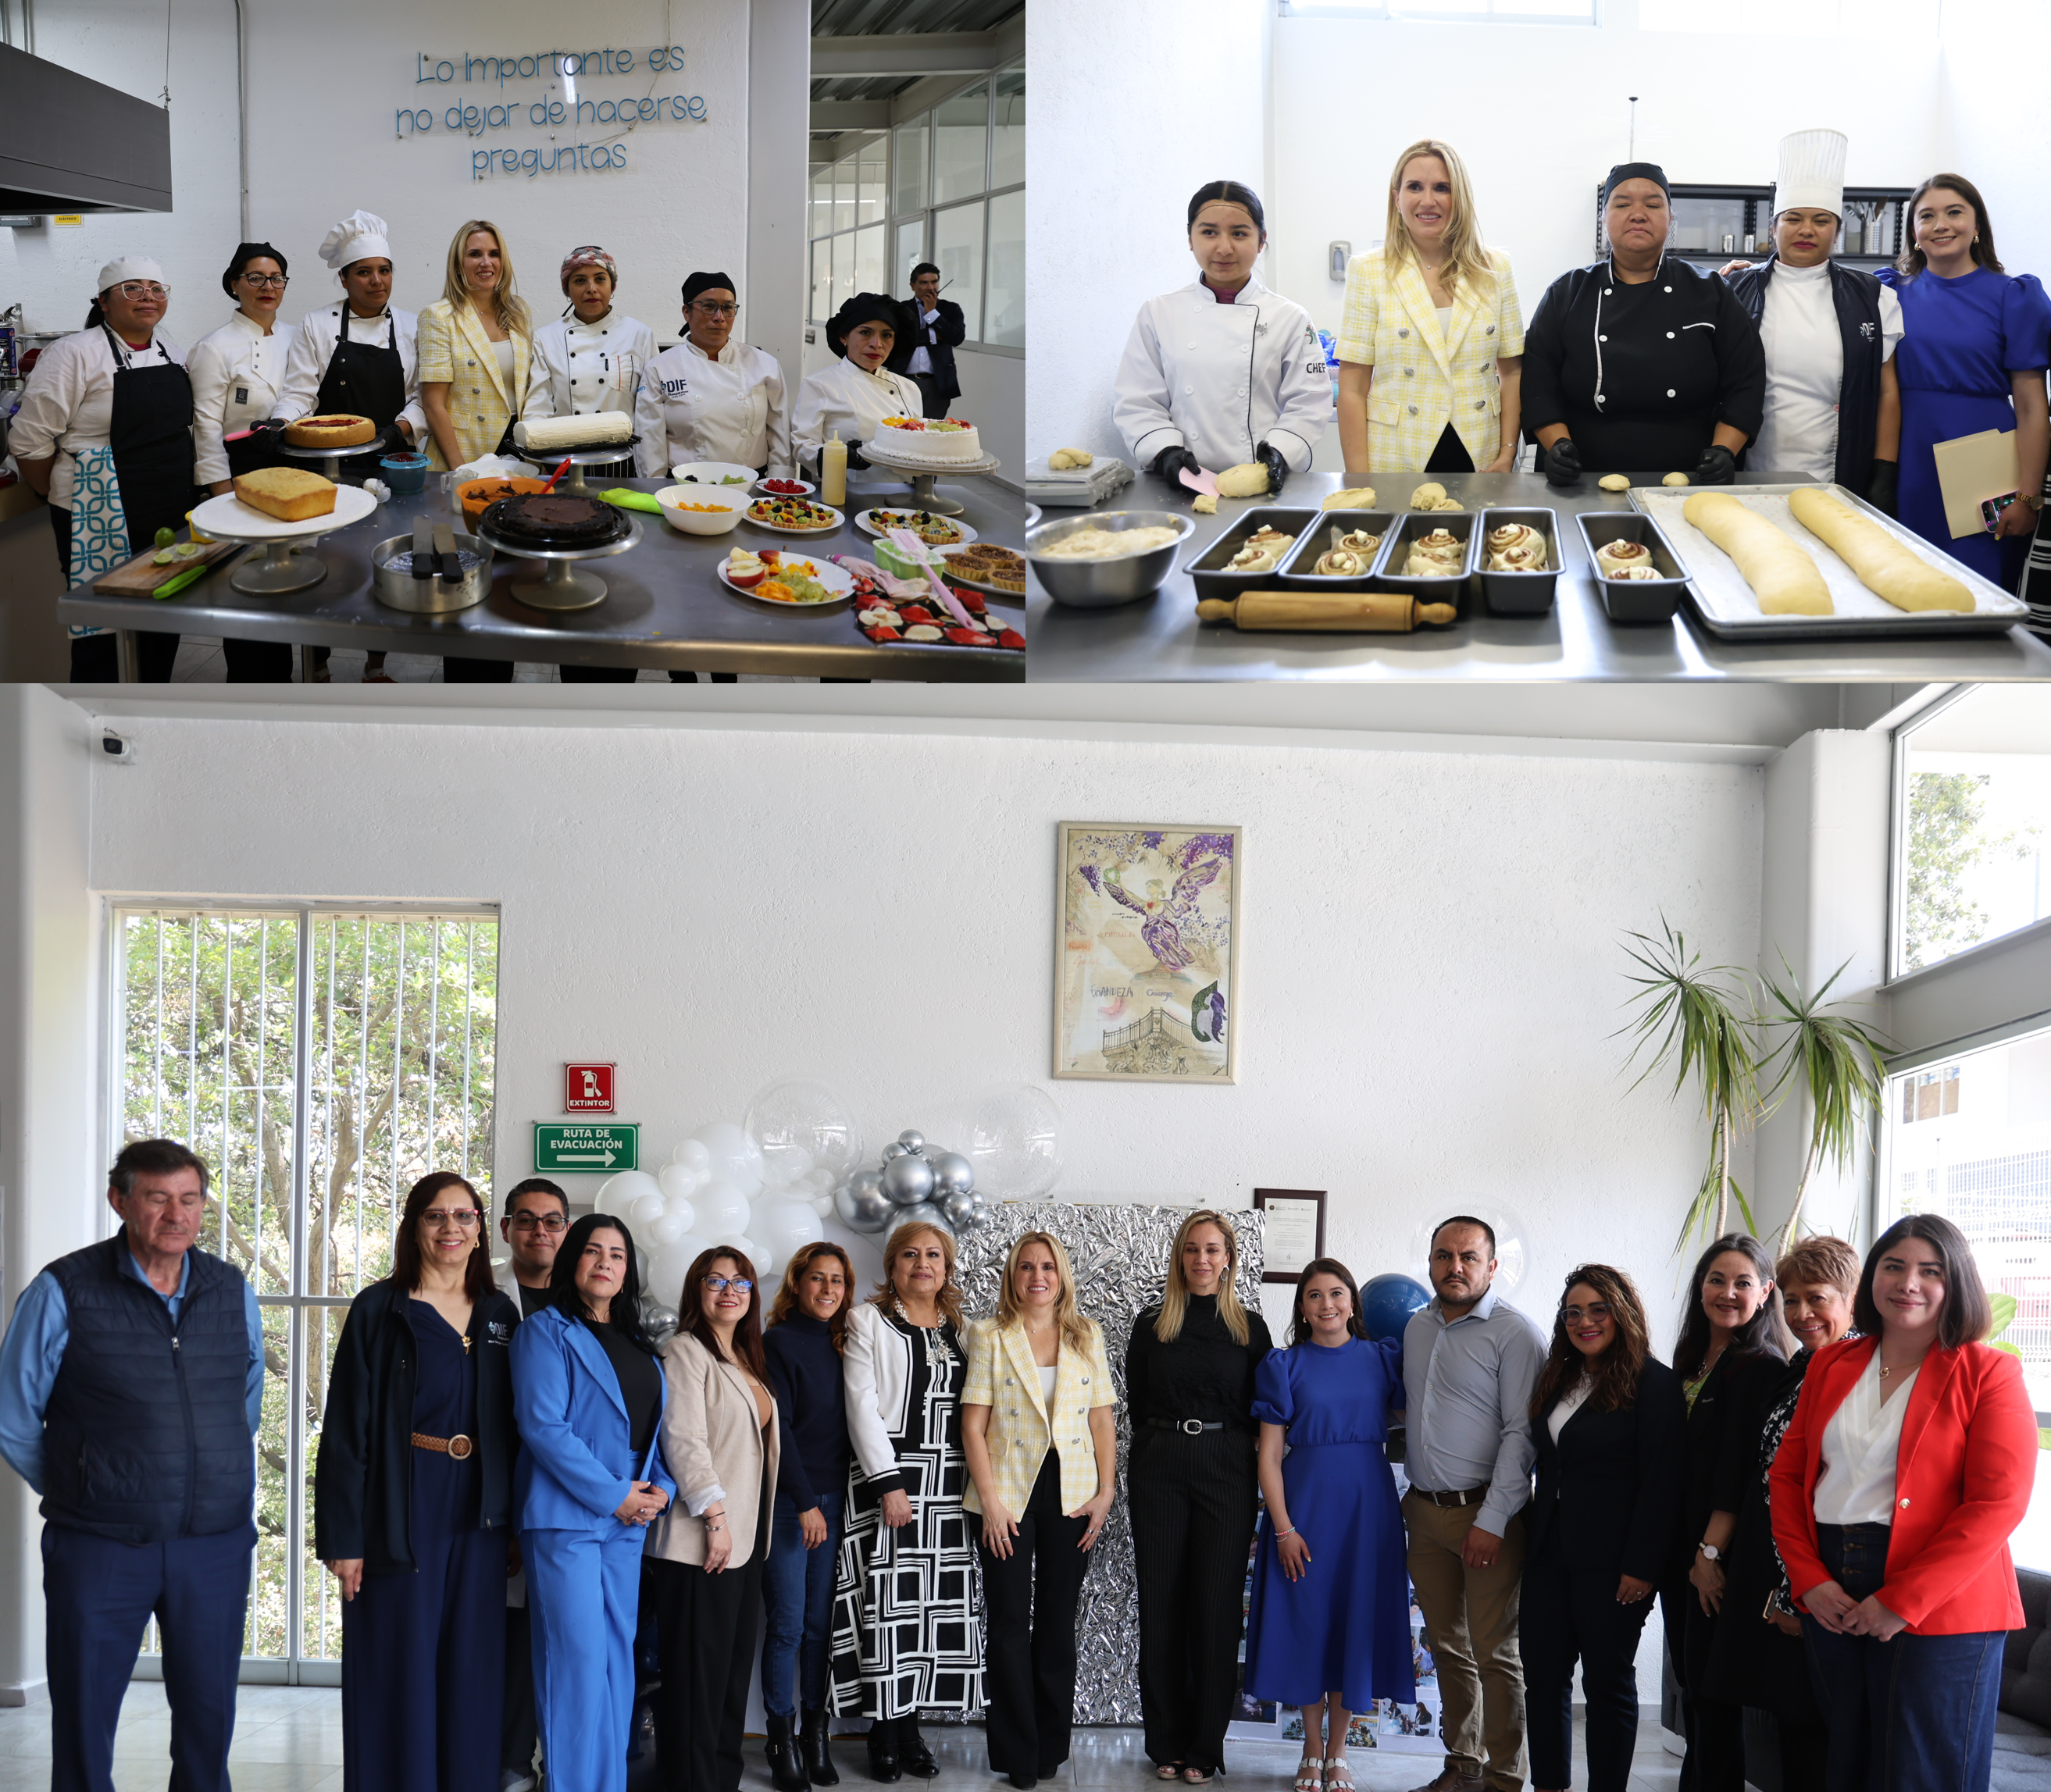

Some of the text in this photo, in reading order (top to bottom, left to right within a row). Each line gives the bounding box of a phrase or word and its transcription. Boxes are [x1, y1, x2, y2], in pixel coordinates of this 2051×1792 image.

[416, 52, 455, 84] Lo
[648, 46, 684, 71] es
[397, 93, 707, 136] no dejar de hacerse
[473, 142, 627, 180] preguntas
[1306, 362, 1326, 373] CHEF
[666, 379, 687, 392] DIF
[1090, 984, 1134, 998] GRANDEZA
[563, 1129, 610, 1138] RUTA DE
[550, 1138, 622, 1149] EVACUACIÓN
[494, 1323, 507, 1336] DIF
